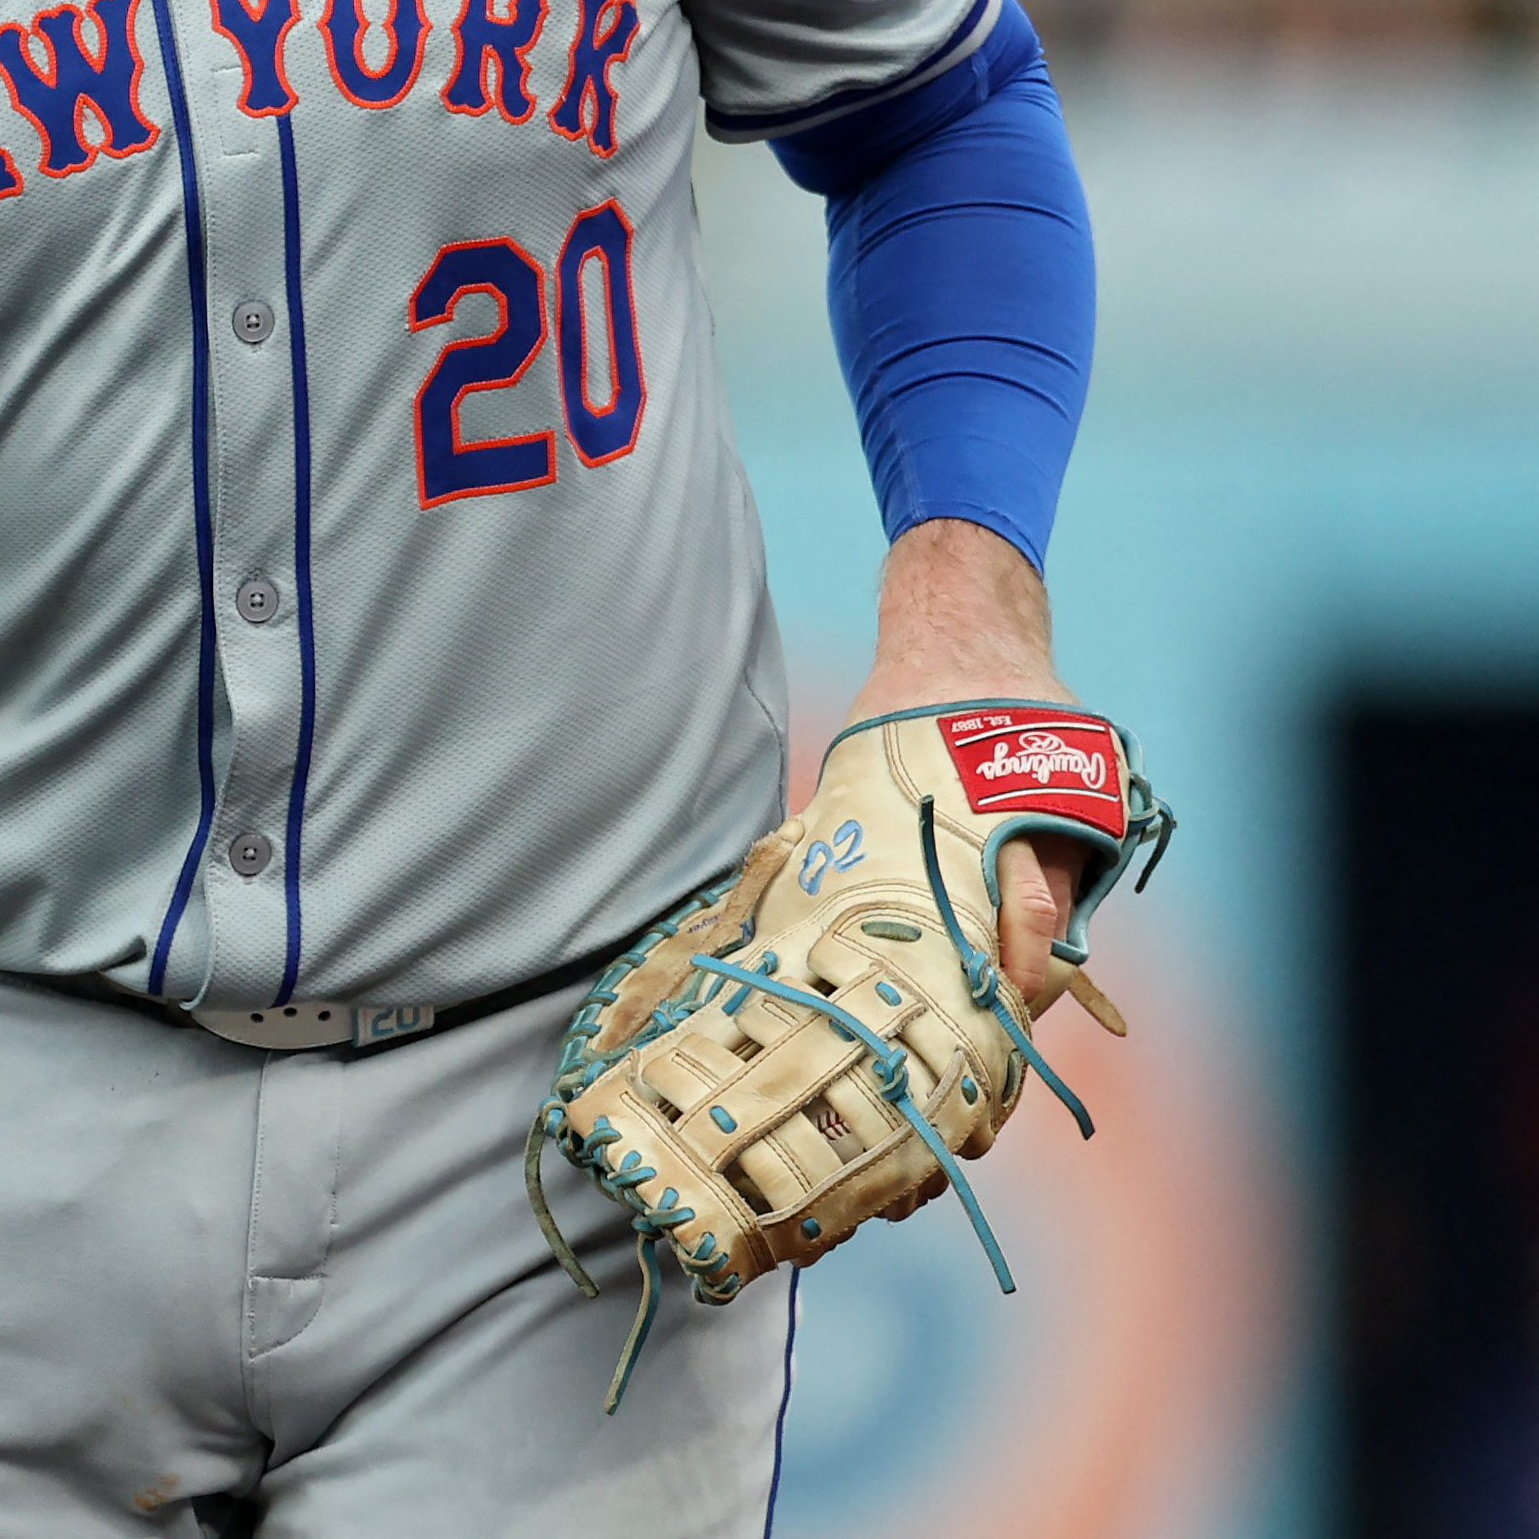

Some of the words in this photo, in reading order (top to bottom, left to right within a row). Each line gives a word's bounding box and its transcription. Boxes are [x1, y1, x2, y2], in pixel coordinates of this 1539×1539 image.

[408, 197, 648, 510] 20
[984, 715, 1013, 728] Est.
[976, 742, 1106, 790] Rawlings
[371, 1006, 421, 1037] 20
